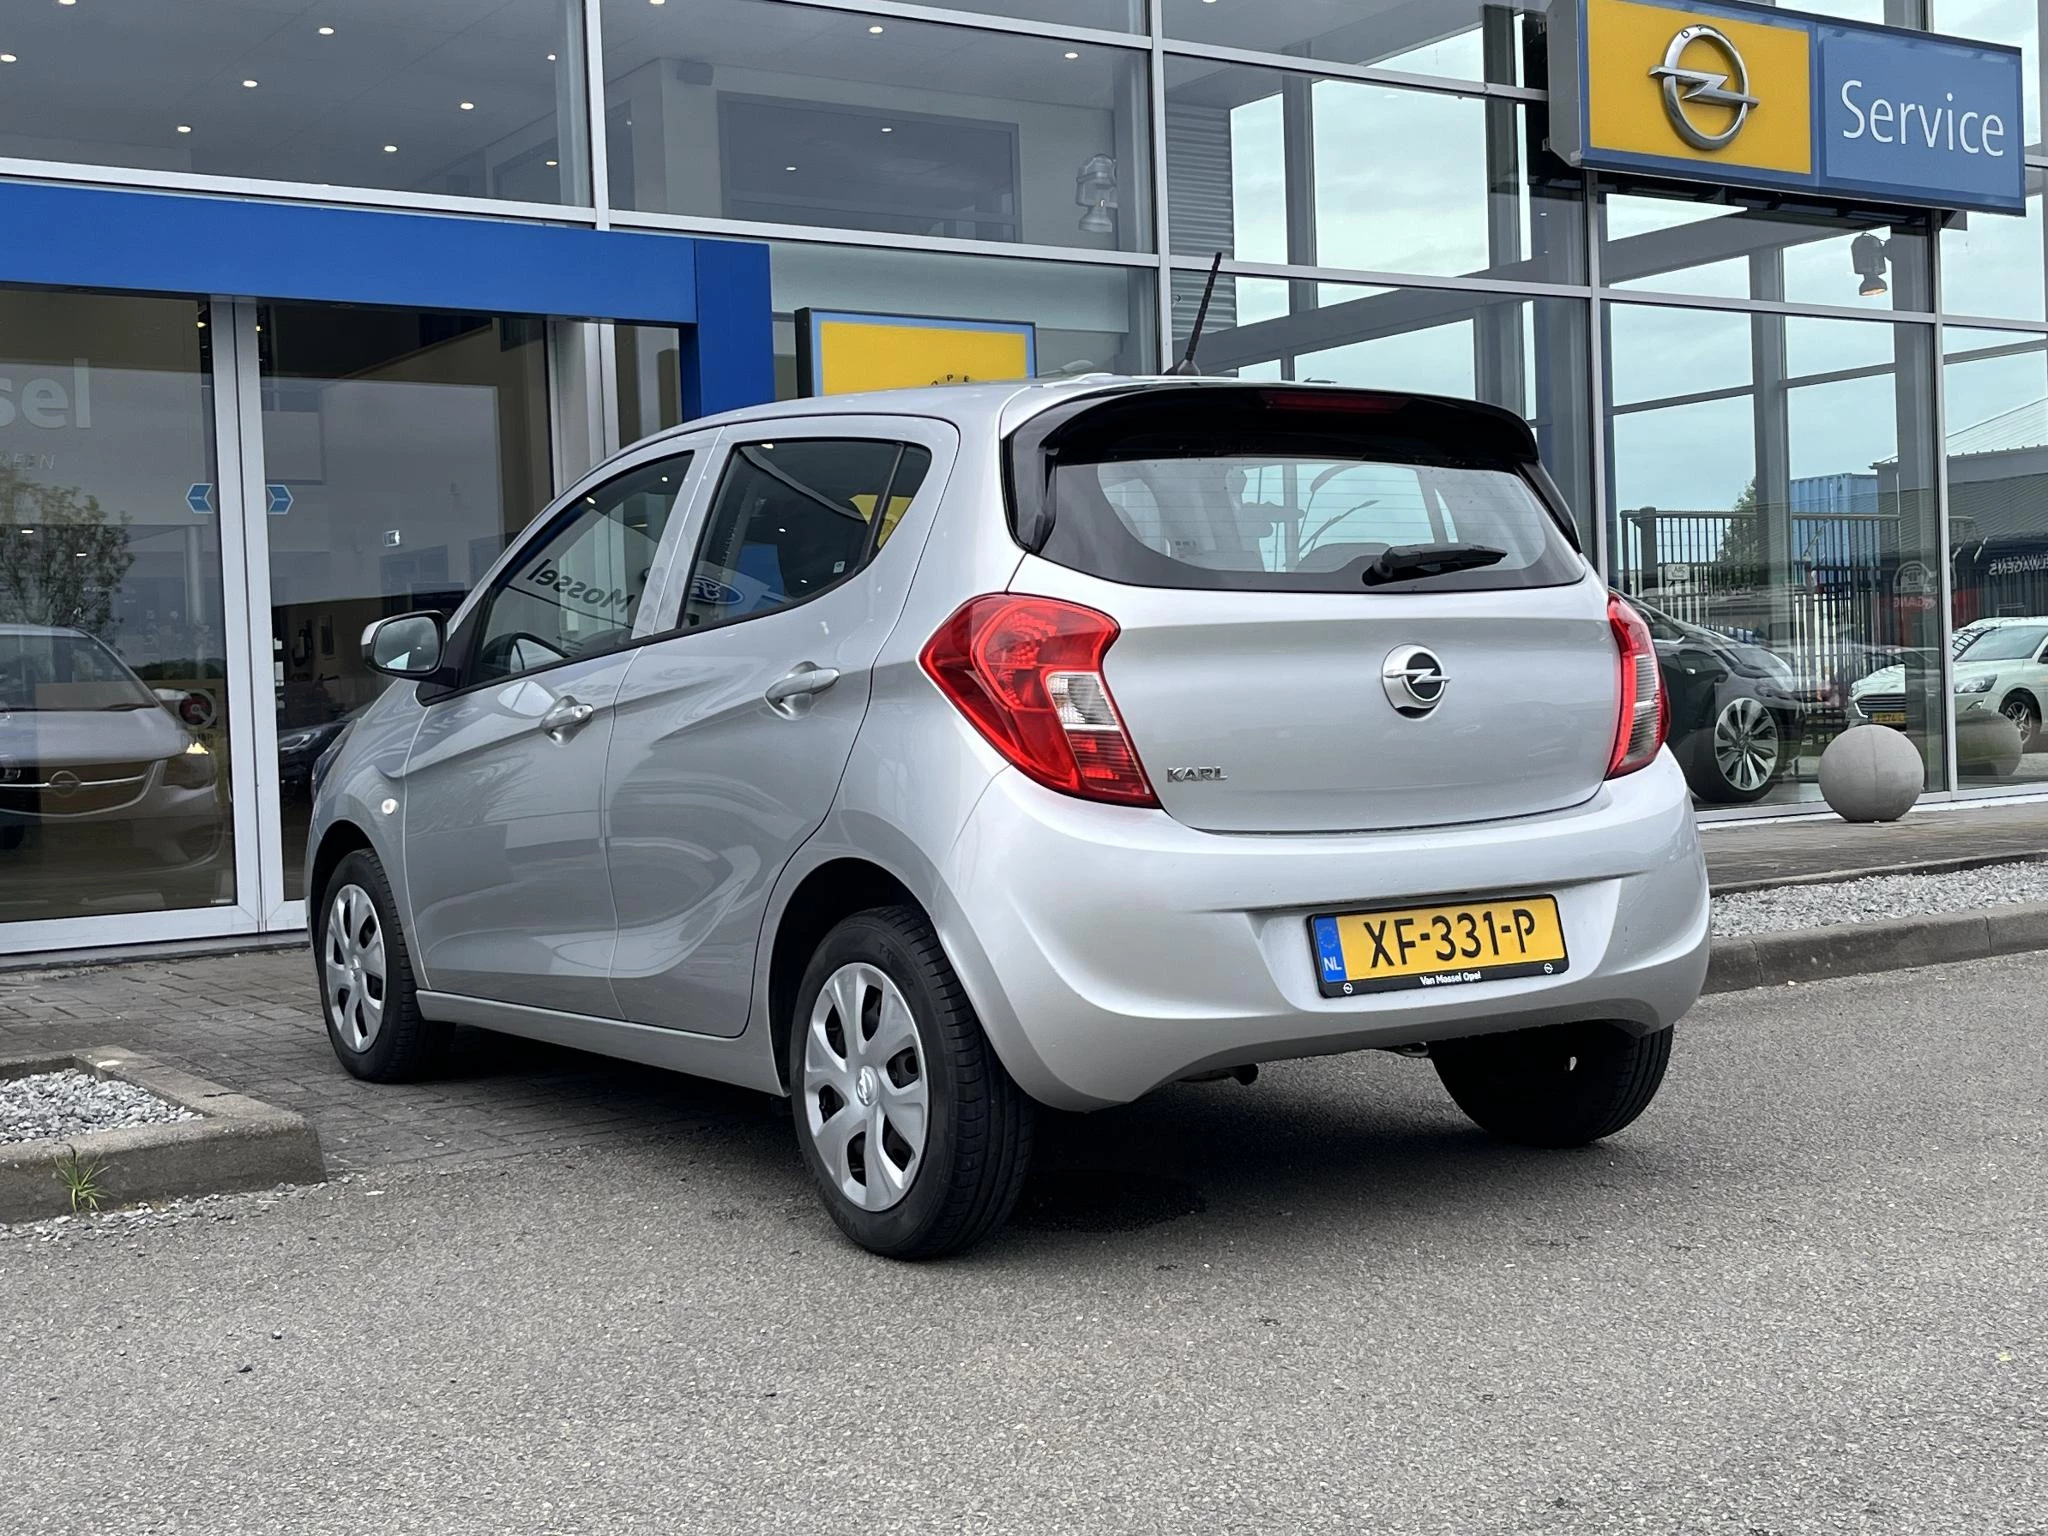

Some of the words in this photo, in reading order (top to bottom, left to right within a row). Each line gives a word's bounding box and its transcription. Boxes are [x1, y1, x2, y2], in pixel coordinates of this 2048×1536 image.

[1841, 80, 2004, 156] Service
[1167, 766, 1228, 782] KARL
[1363, 908, 1536, 969] XF-331-P
[1323, 957, 1343, 972] NL
[1419, 976, 1436, 986] Van
[1435, 972, 1462, 984] Mossel
[1462, 970, 1482, 982] Opel
